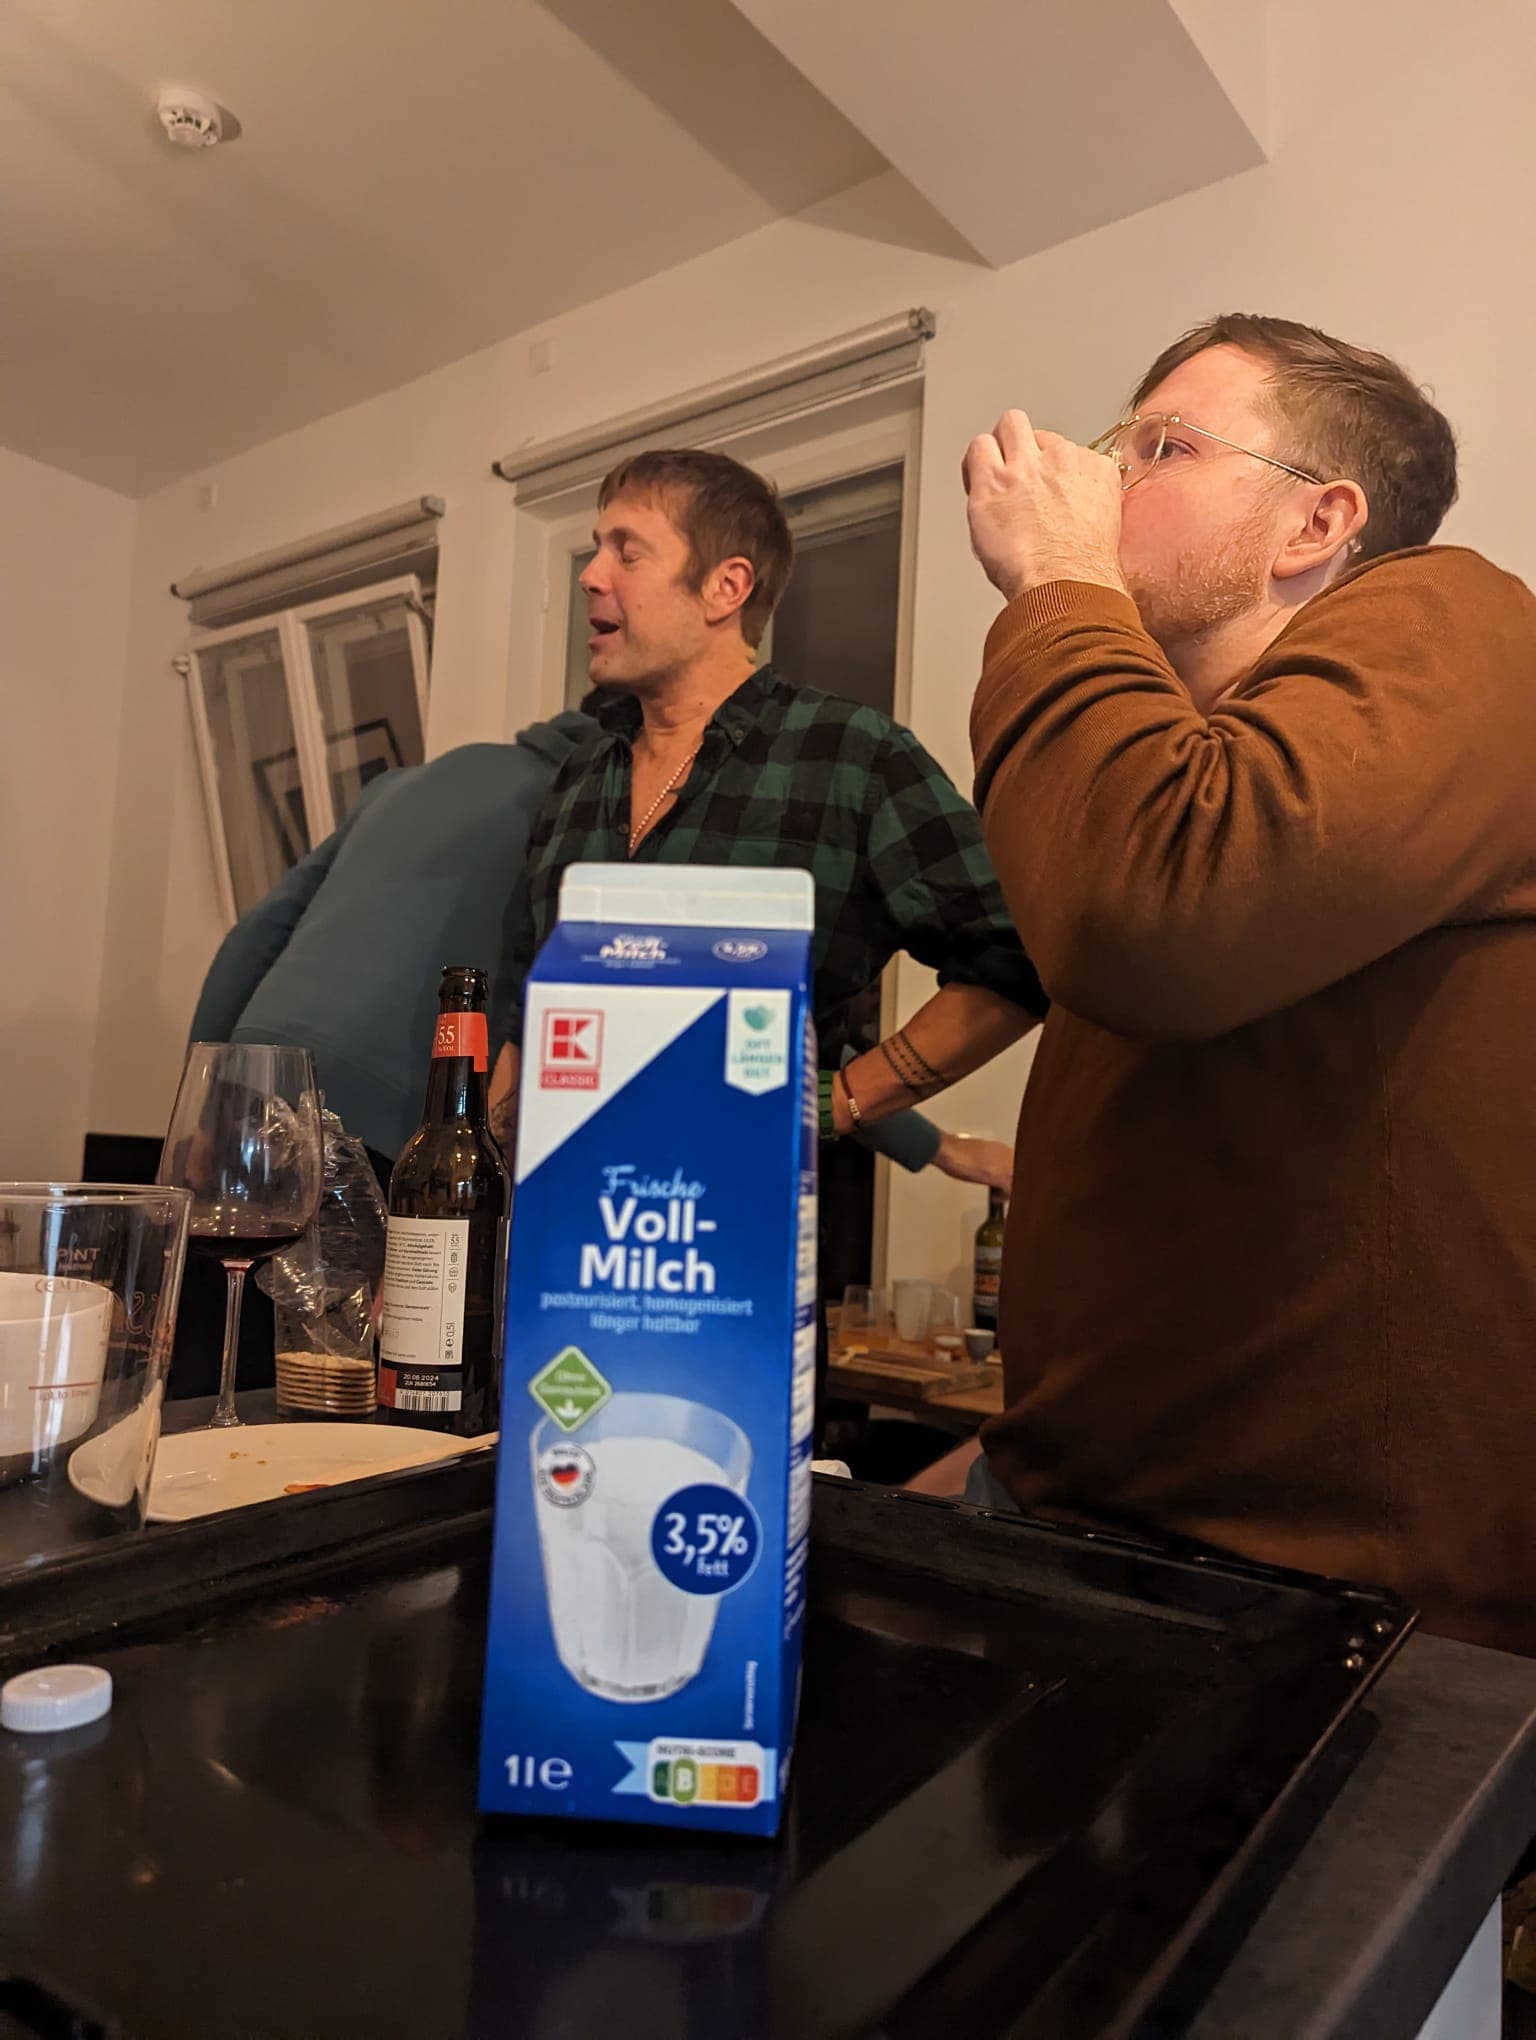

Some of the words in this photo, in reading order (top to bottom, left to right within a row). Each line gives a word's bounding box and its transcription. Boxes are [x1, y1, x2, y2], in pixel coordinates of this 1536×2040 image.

[600, 1164, 707, 1199] Frische
[598, 1197, 718, 1244] Voll-
[579, 1244, 716, 1293] Milch
[540, 1290, 641, 1314] pasteurisiert,
[643, 1295, 754, 1317] homogenisiert
[589, 1313, 639, 1335] länger
[642, 1314, 702, 1334] haltbar
[664, 1512, 749, 1565] 3,5%
